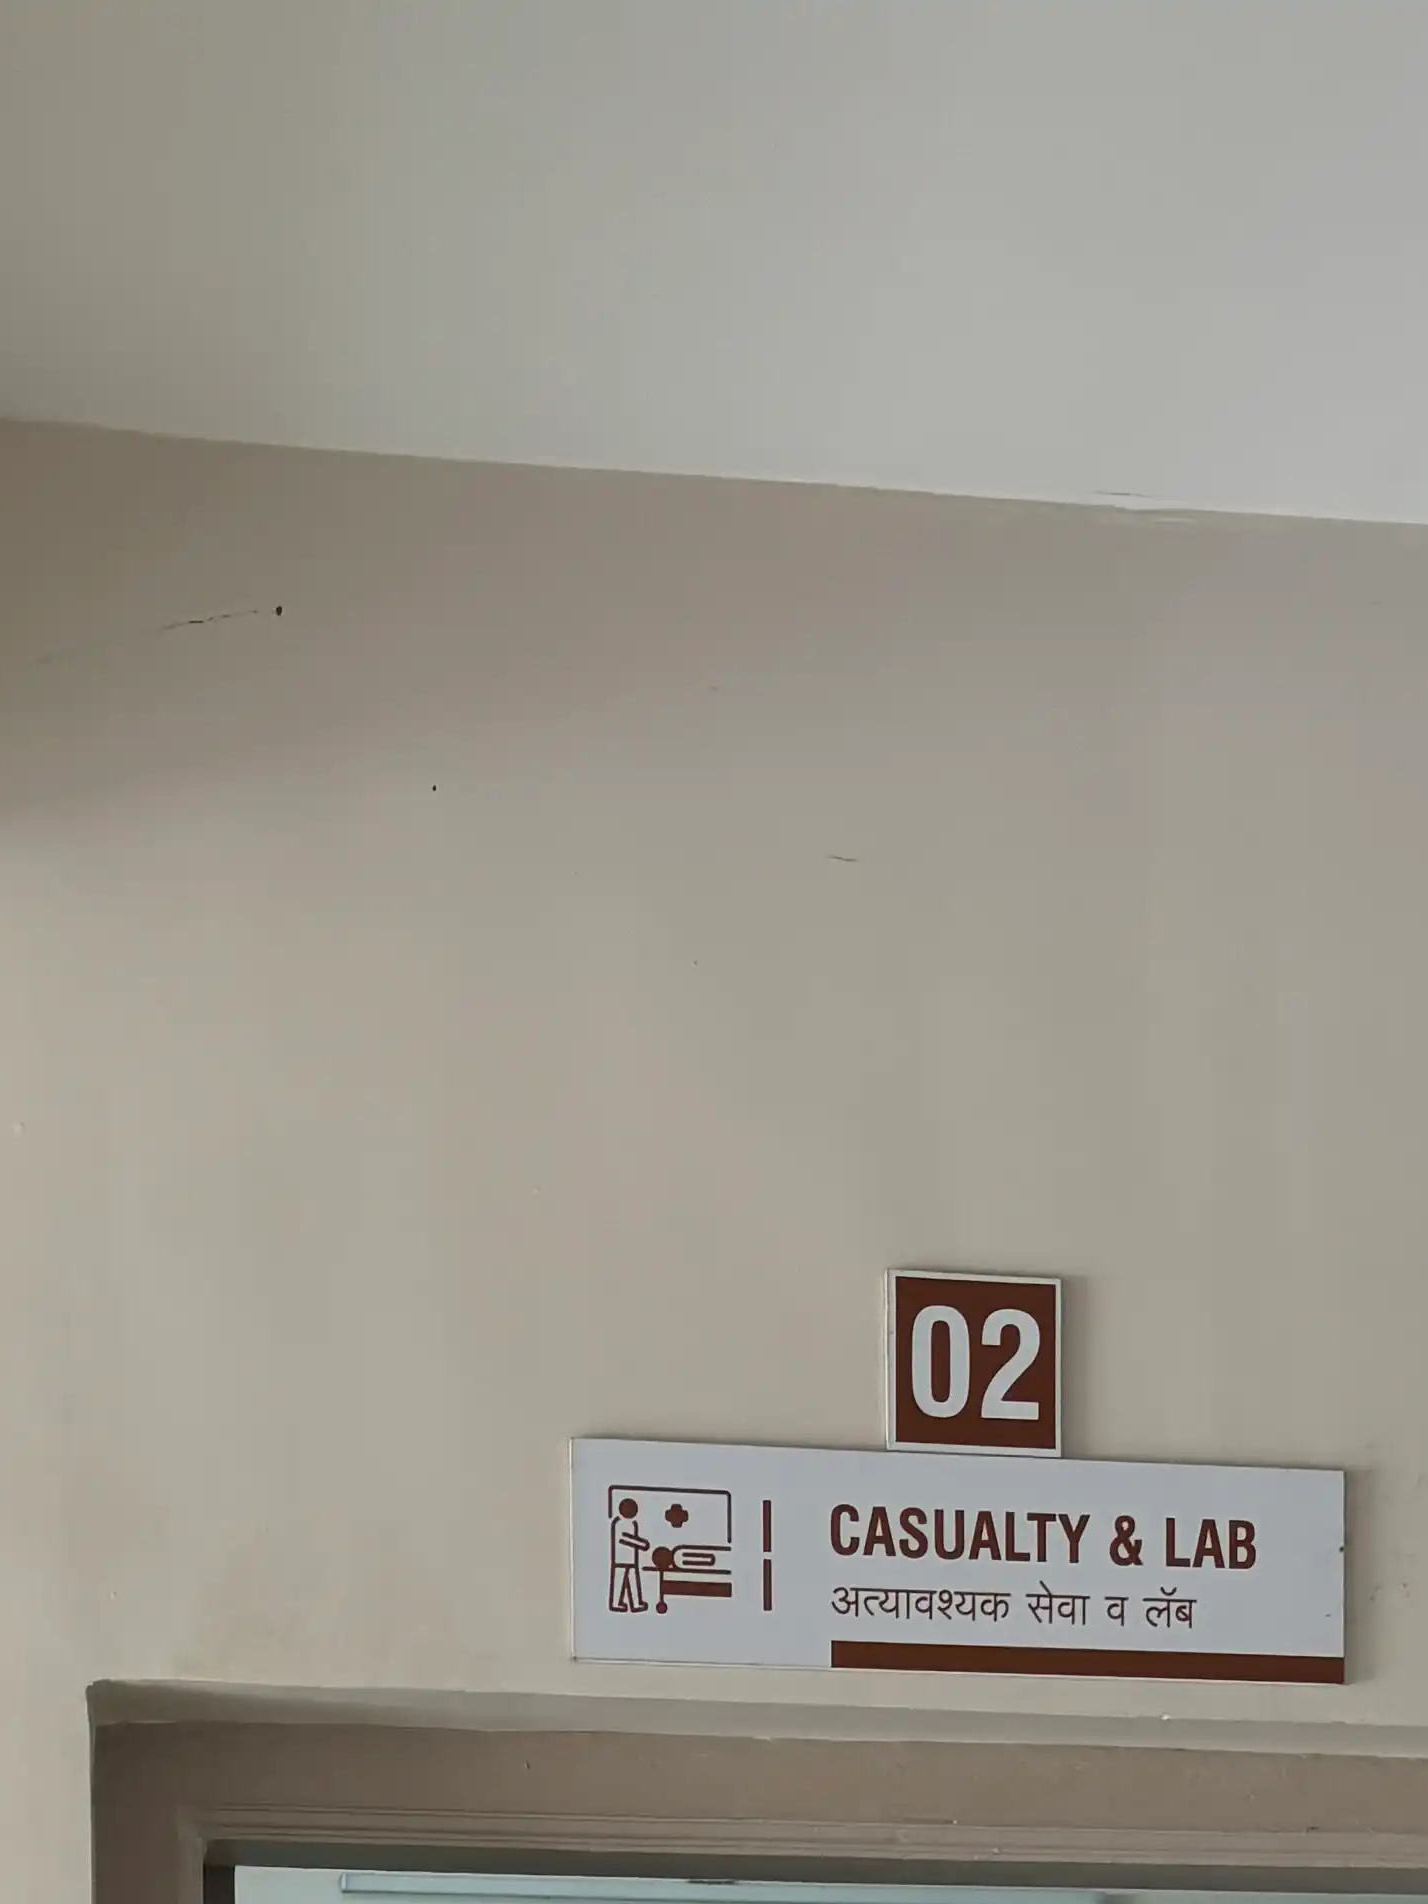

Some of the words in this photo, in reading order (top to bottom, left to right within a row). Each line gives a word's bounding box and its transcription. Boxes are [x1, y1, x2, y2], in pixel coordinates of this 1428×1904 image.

[912, 1306, 1040, 1420] 02
[831, 1504, 1090, 1563] CASUALTY
[1110, 1515, 1143, 1566] &
[1166, 1518, 1256, 1569] LAB
[831, 1587, 1011, 1622] अत्यावश्यक
[1025, 1580, 1090, 1625] सेवा
[1104, 1596, 1129, 1626] व
[1143, 1587, 1197, 1628] लॅब
